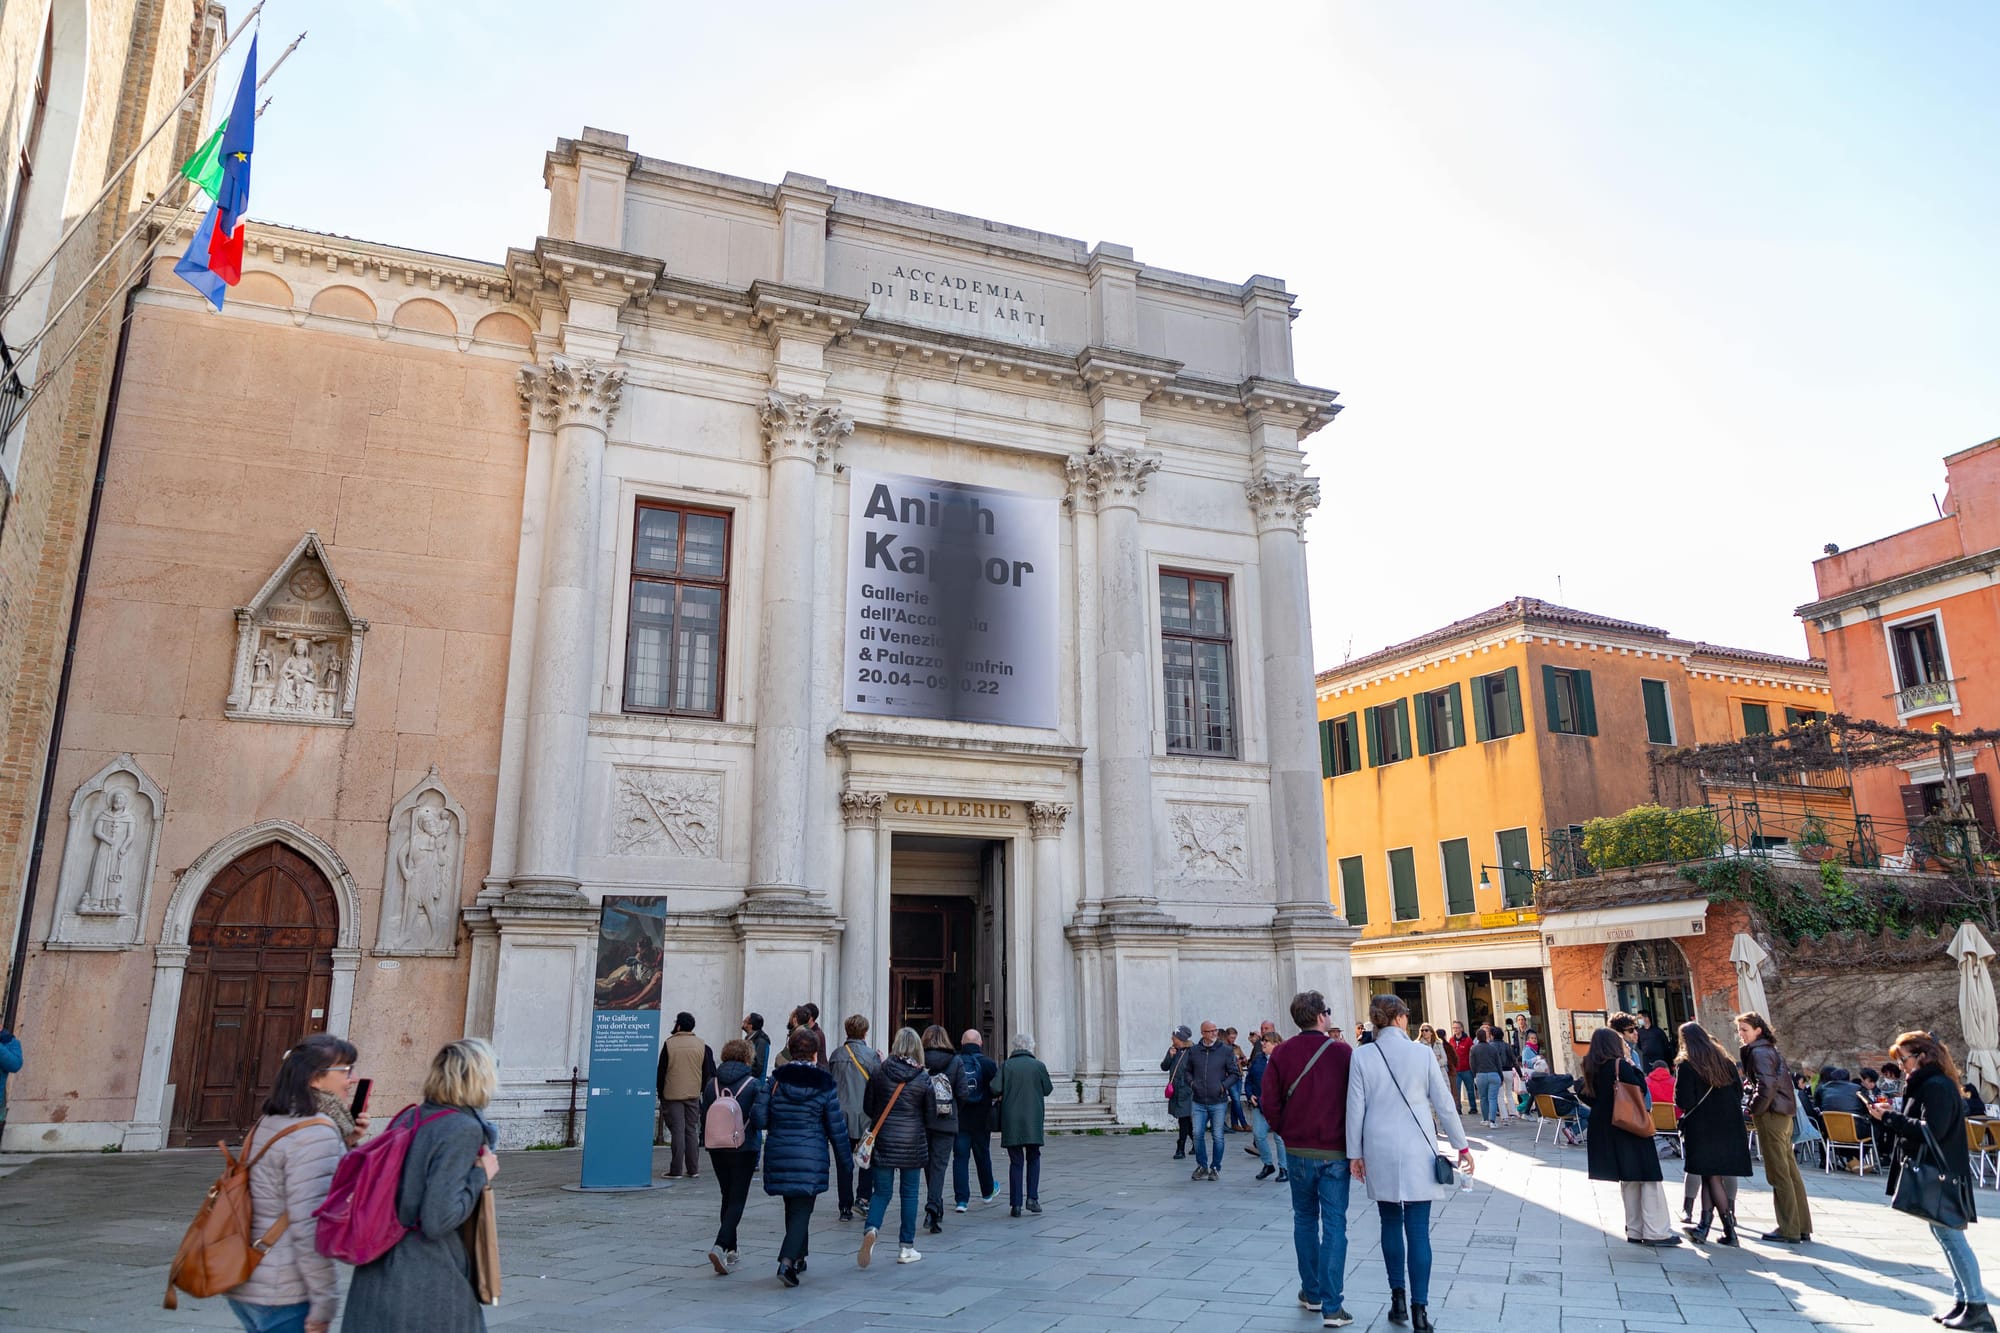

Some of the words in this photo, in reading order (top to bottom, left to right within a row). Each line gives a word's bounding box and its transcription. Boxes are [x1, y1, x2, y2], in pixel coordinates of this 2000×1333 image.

[894, 265, 1025, 302] ACCADEMIA
[871, 281, 893, 297] DI
[909, 288, 979, 314] BELLE
[994, 306, 1046, 326] ARTI
[864, 483, 995, 535] Anih
[864, 531, 1034, 588] Kaor
[861, 584, 929, 606] Gallerie
[860, 626, 875, 641] di
[859, 646, 873, 662] &
[876, 648, 944, 669] Palazzo
[894, 798, 1011, 819] GALLERIE
[596, 1014, 610, 1022] The
[611, 1014, 638, 1022] Gallerie
[610, 1022, 626, 1030] don't
[627, 1023, 650, 1031] expect
